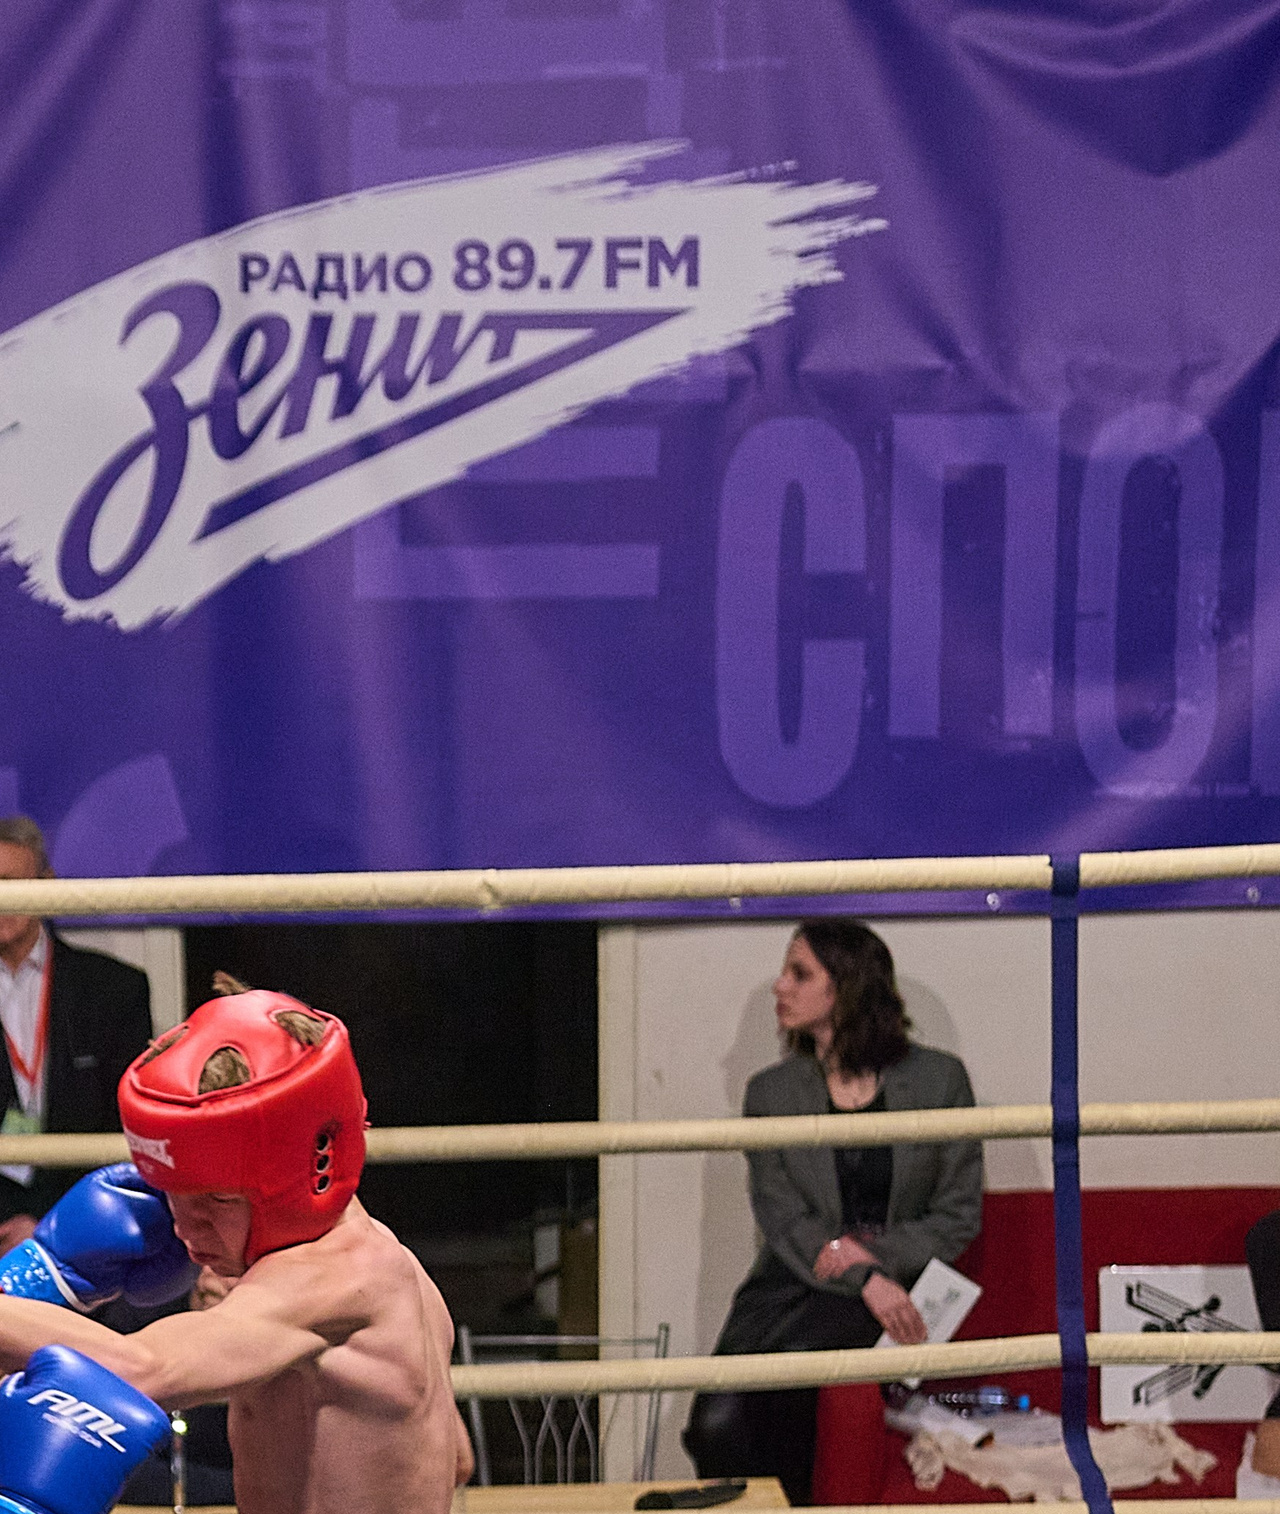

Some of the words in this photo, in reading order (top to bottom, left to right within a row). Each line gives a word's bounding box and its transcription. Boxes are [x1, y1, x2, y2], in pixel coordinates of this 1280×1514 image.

[239, 251, 434, 301] РАДИО
[57, 280, 692, 603] Зенит
[718, 404, 1280, 809] СПО
